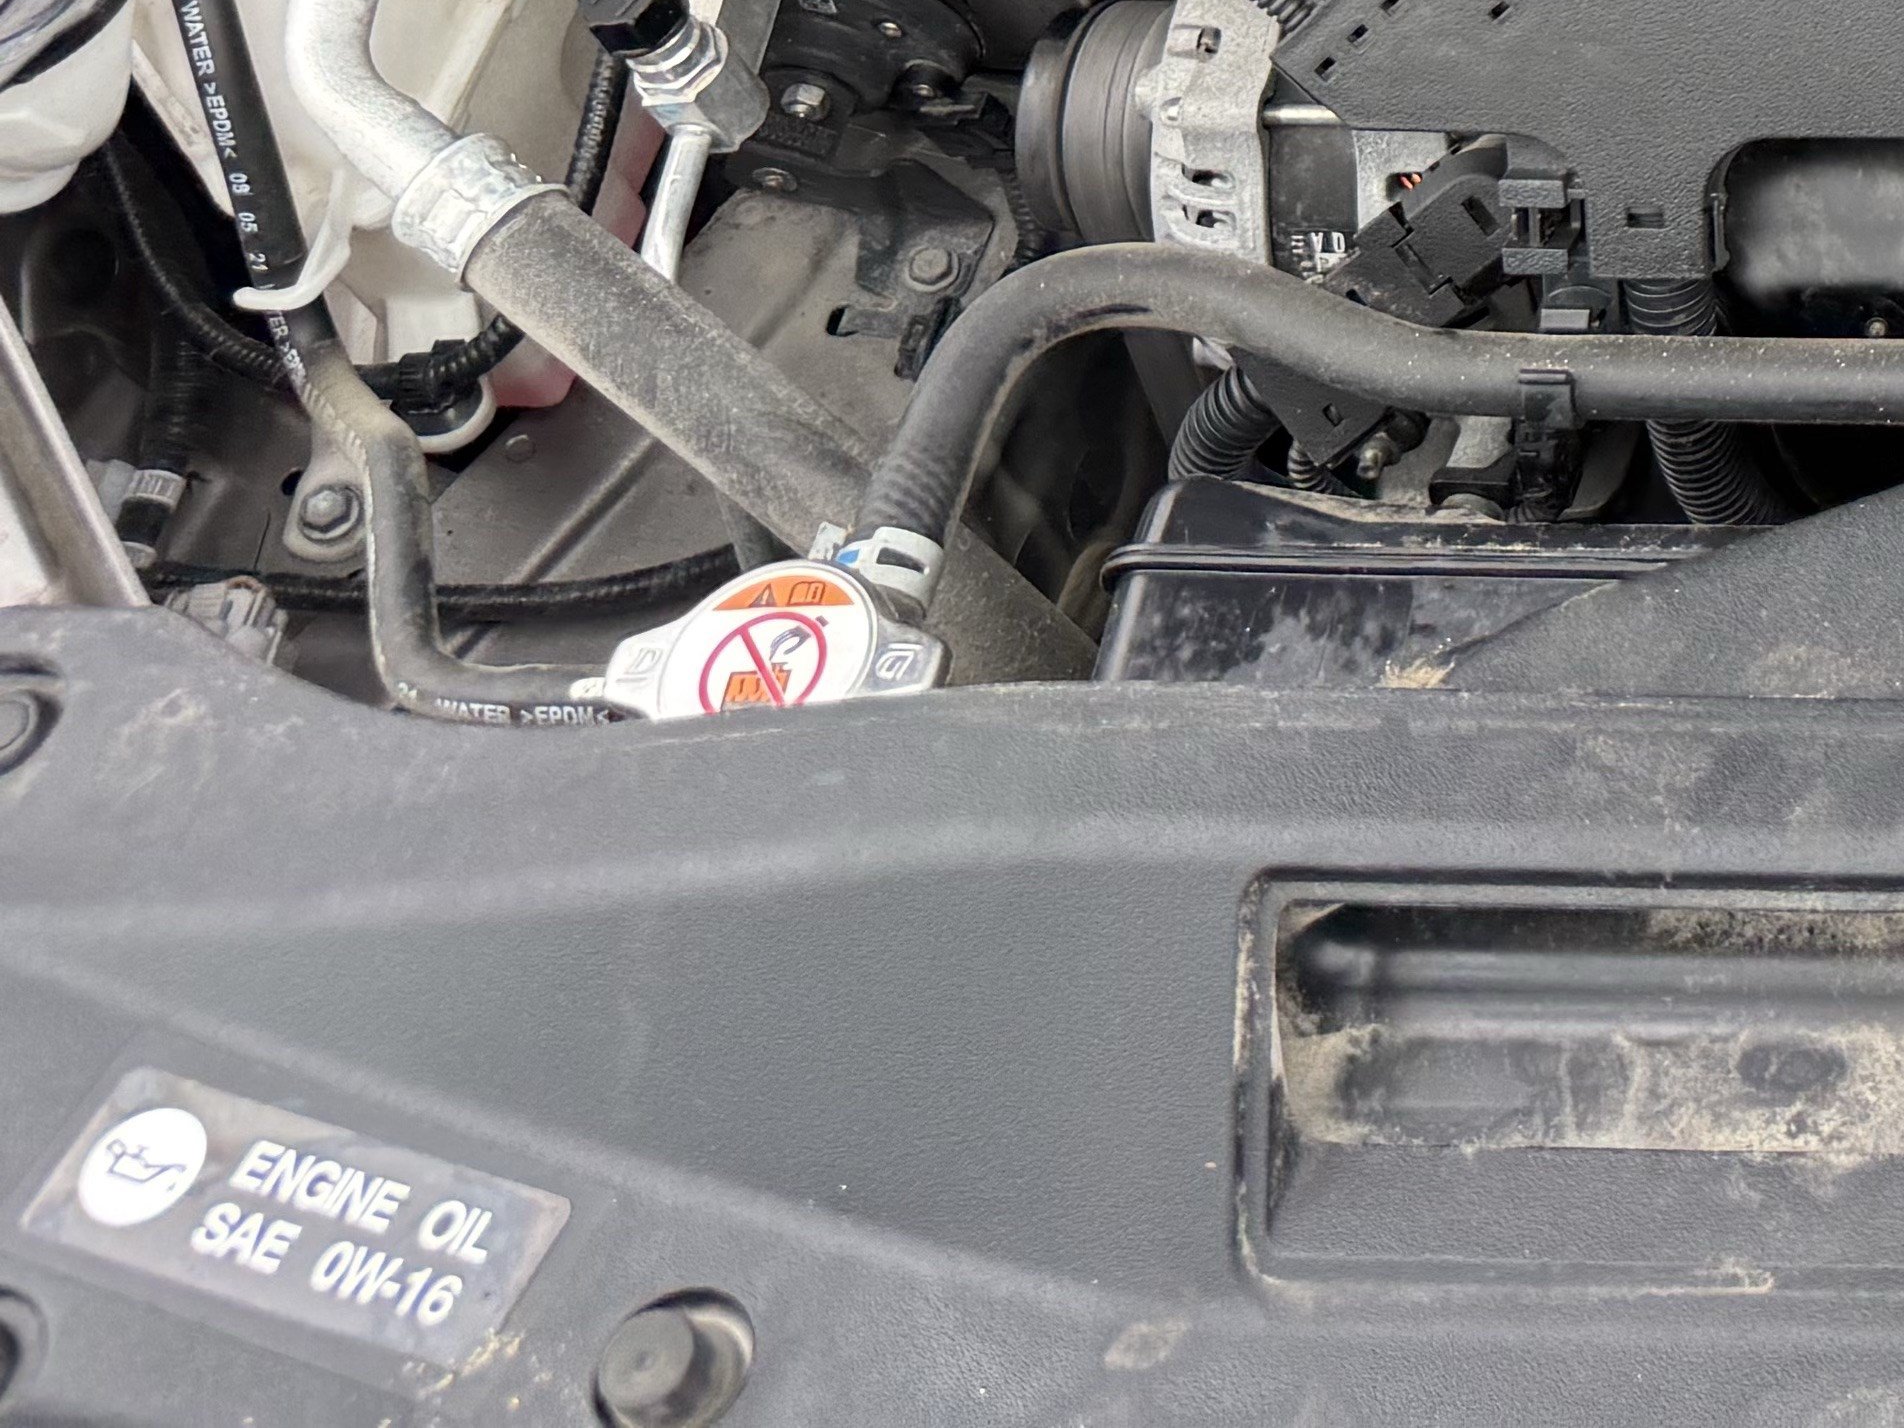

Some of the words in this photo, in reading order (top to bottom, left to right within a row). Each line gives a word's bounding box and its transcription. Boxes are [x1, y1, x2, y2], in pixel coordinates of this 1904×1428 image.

[180, 0, 215, 76] WATER
[190, 1202, 302, 1276] SAE
[308, 1240, 464, 1328] 0W-16
[230, 1140, 410, 1234] ENGINE
[417, 1200, 496, 1265] OIL
